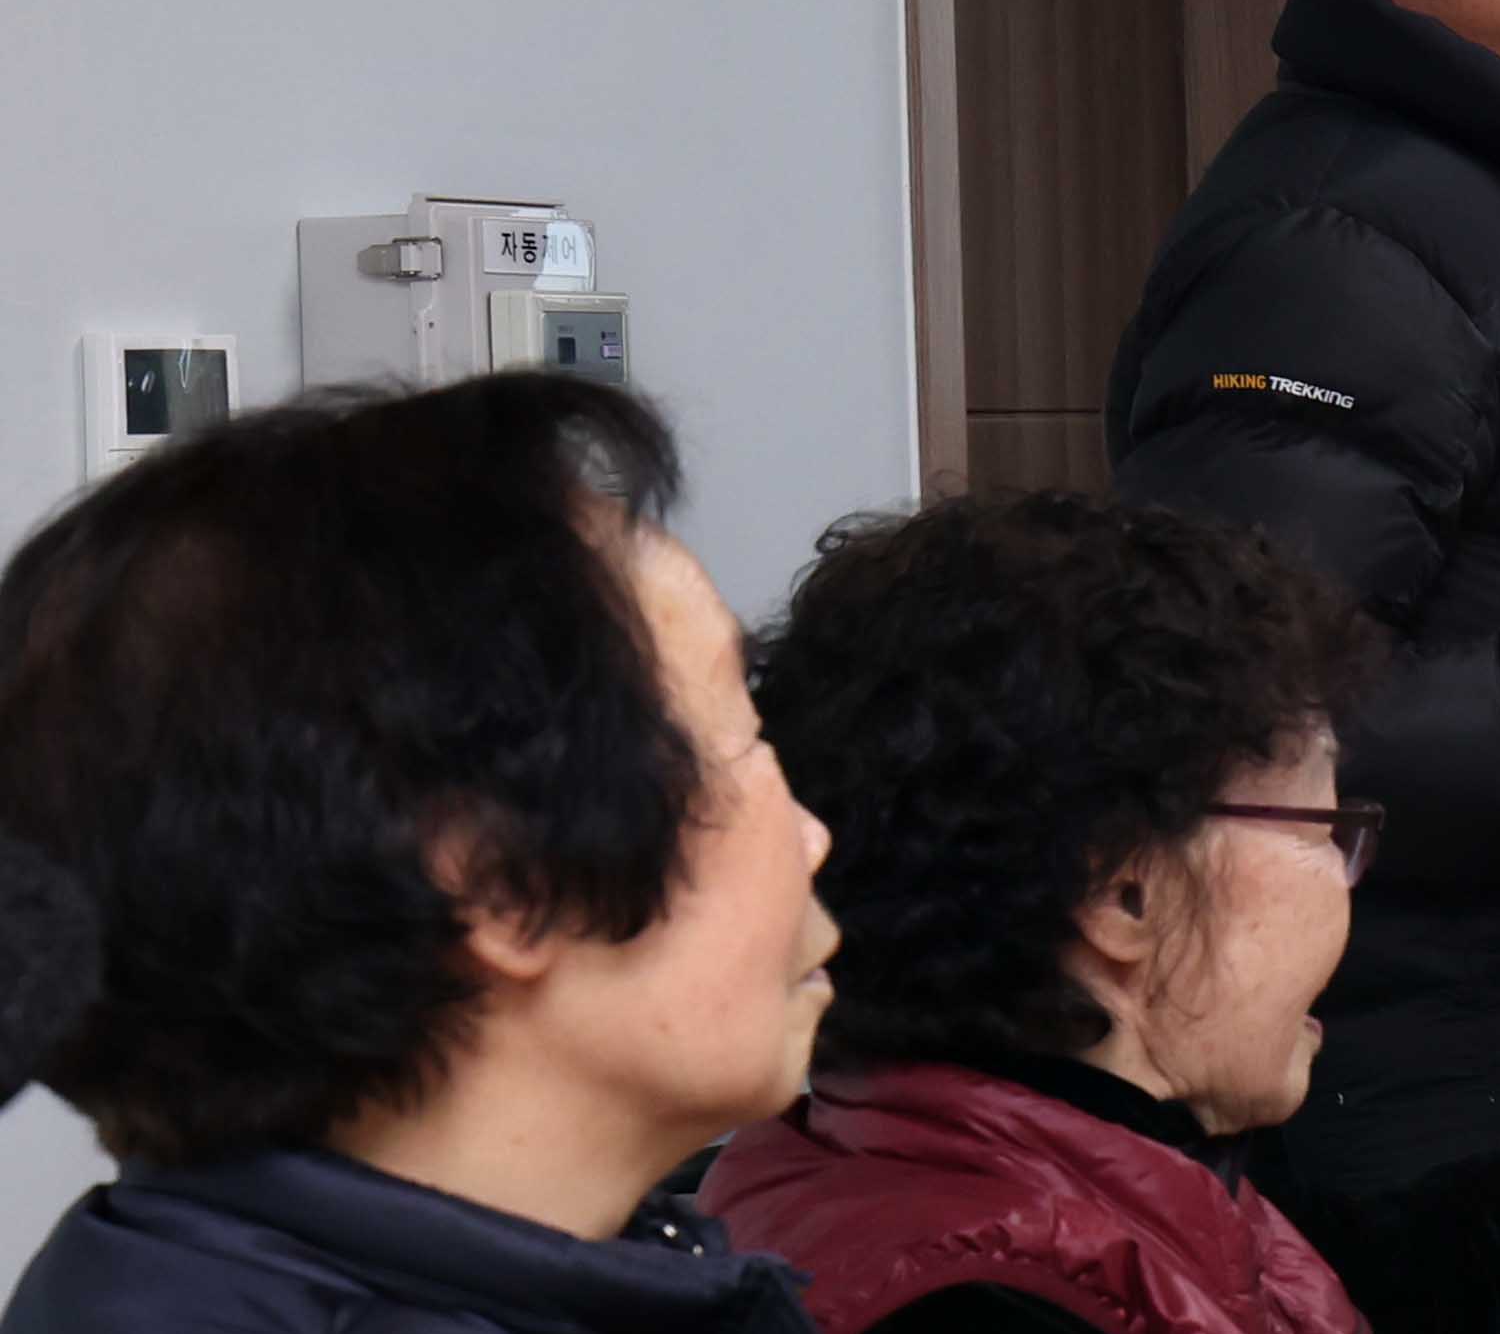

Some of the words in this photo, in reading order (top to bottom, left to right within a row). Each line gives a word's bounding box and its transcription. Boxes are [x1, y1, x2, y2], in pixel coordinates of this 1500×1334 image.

[501, 231, 577, 265] 자동제어
[1213, 373, 1267, 389] HIKING
[1269, 375, 1355, 409] TREKKING
